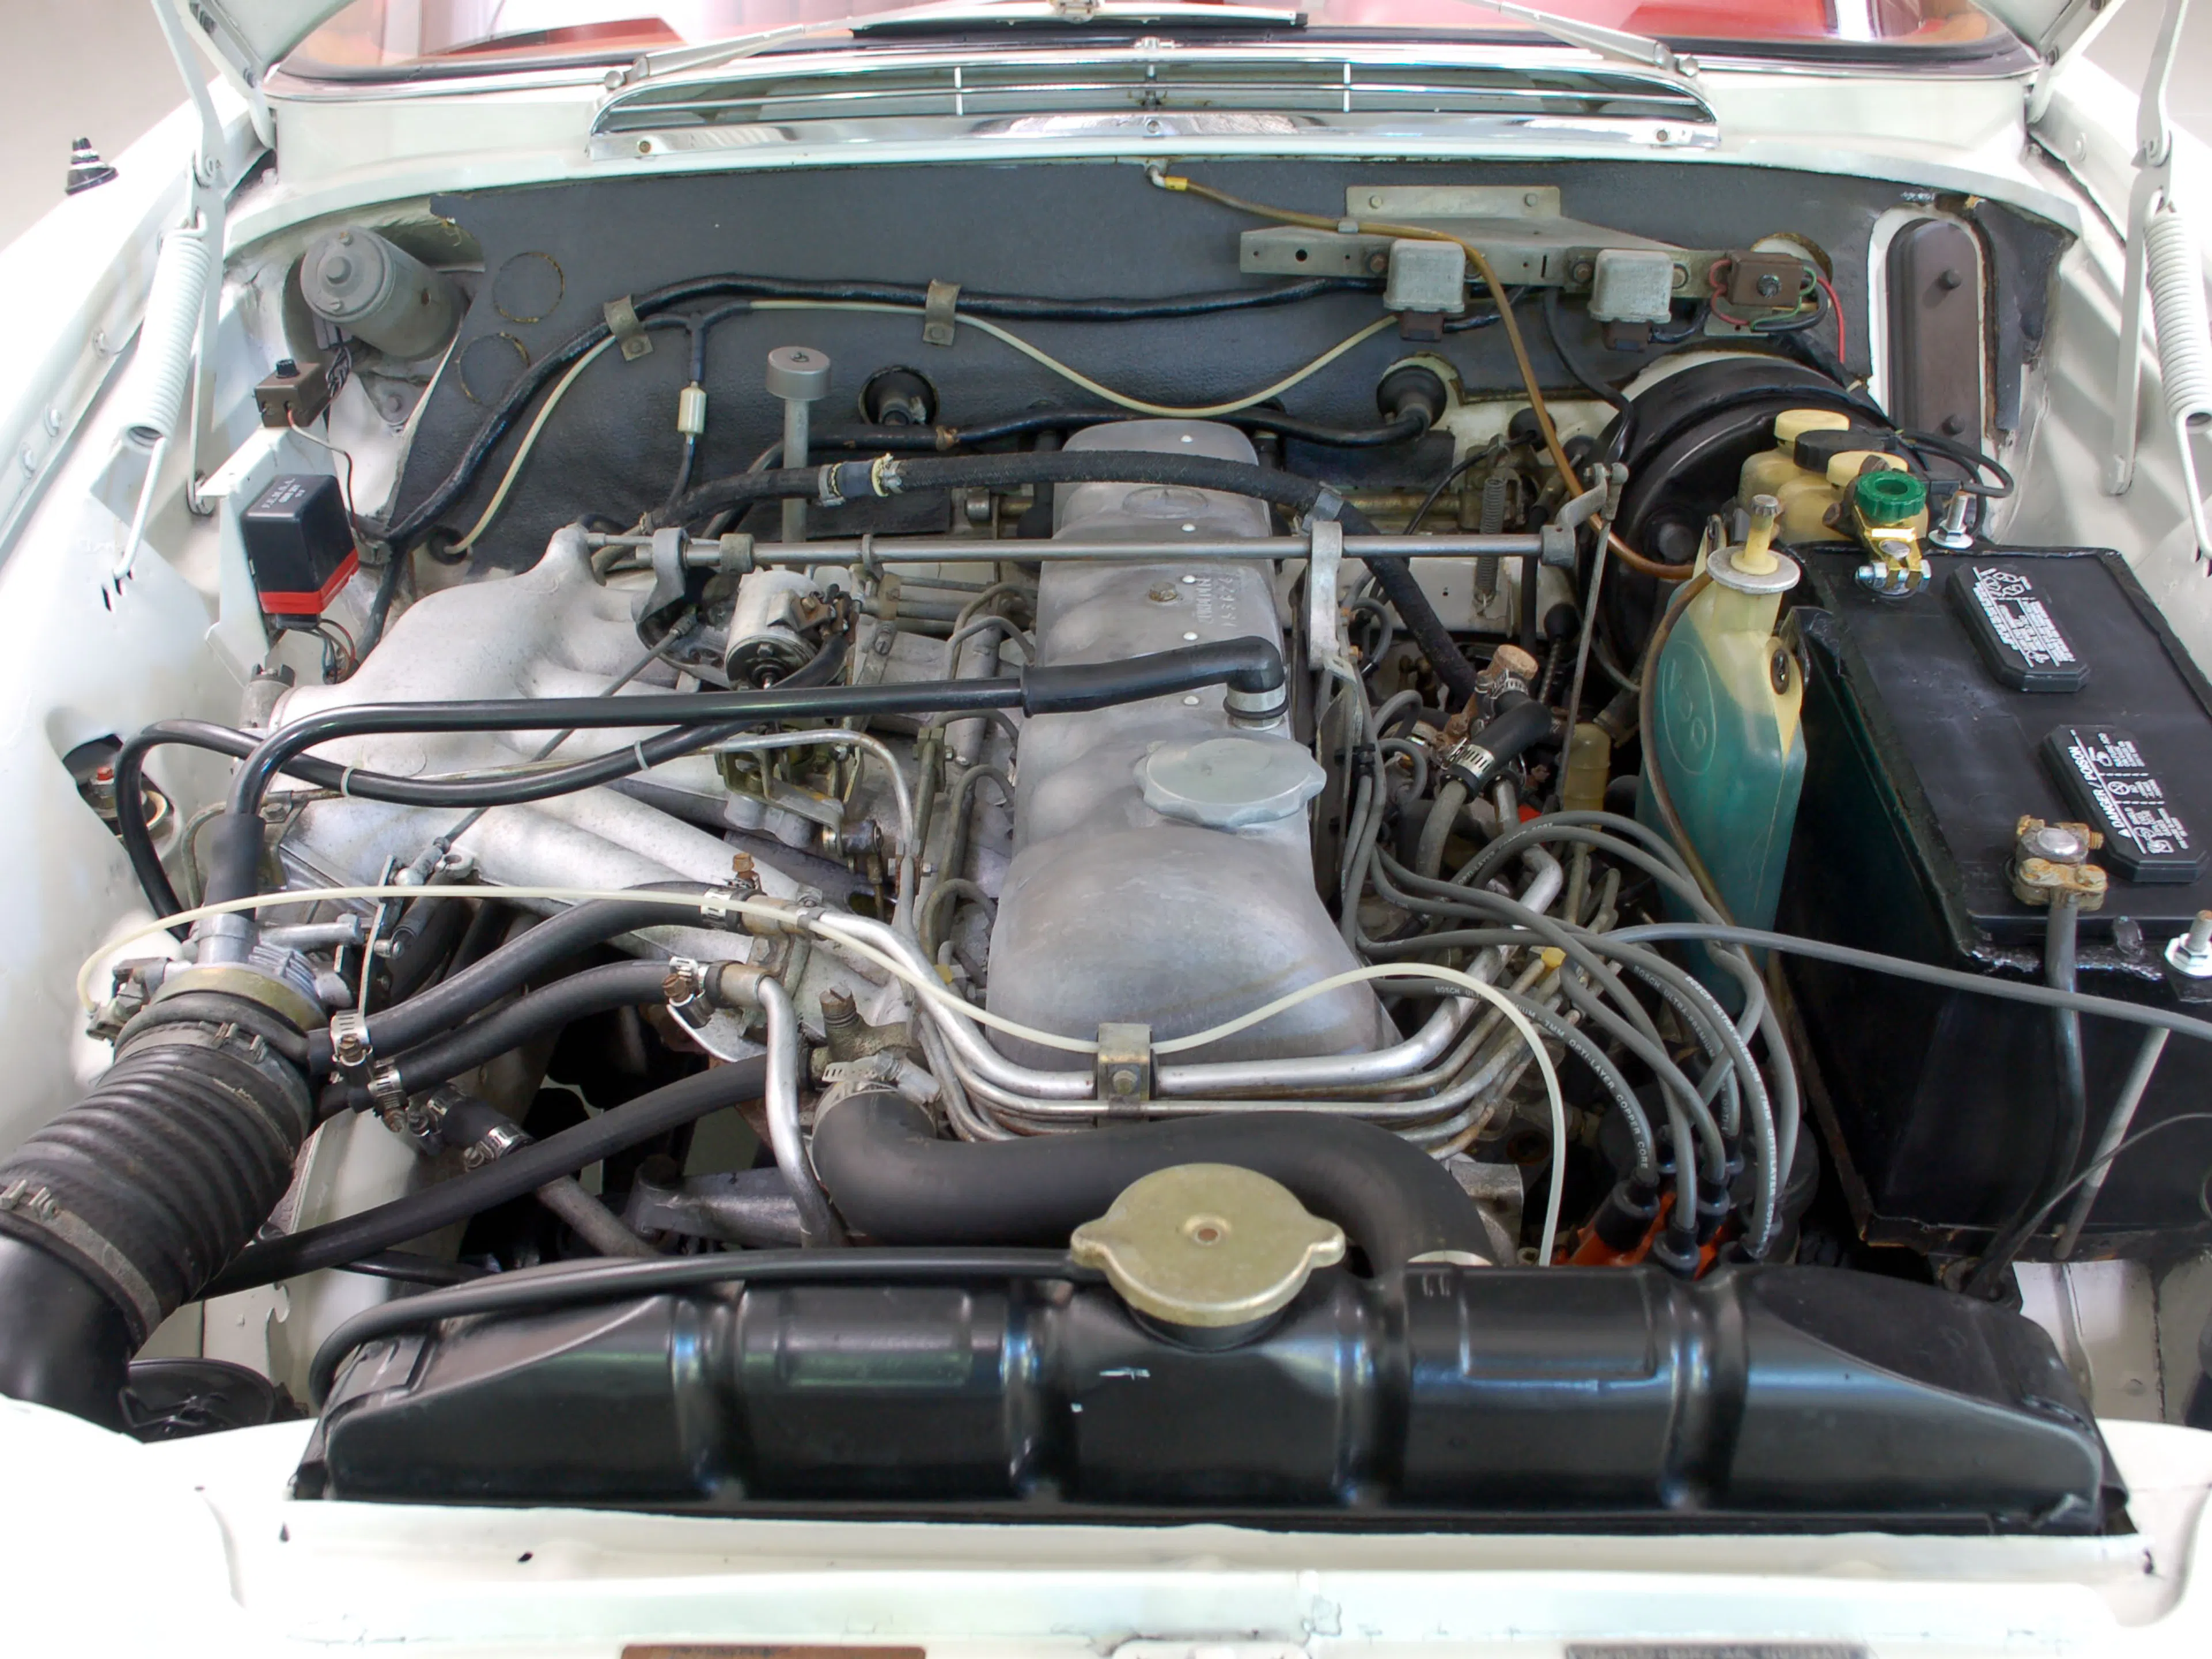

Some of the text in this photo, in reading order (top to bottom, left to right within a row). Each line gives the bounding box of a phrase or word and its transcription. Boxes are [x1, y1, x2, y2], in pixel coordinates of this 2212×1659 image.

[2067, 746, 2097, 781] POISON
[2092, 789, 2126, 828] DANGER
[1435, 986, 1460, 994] BOSCH
[1545, 1019, 1565, 1037] 7MM
[1569, 1039, 1615, 1089] OPTI-LAYER
[1616, 1094, 1641, 1134] COPPER
[1638, 1141, 1648, 1169] CORE
